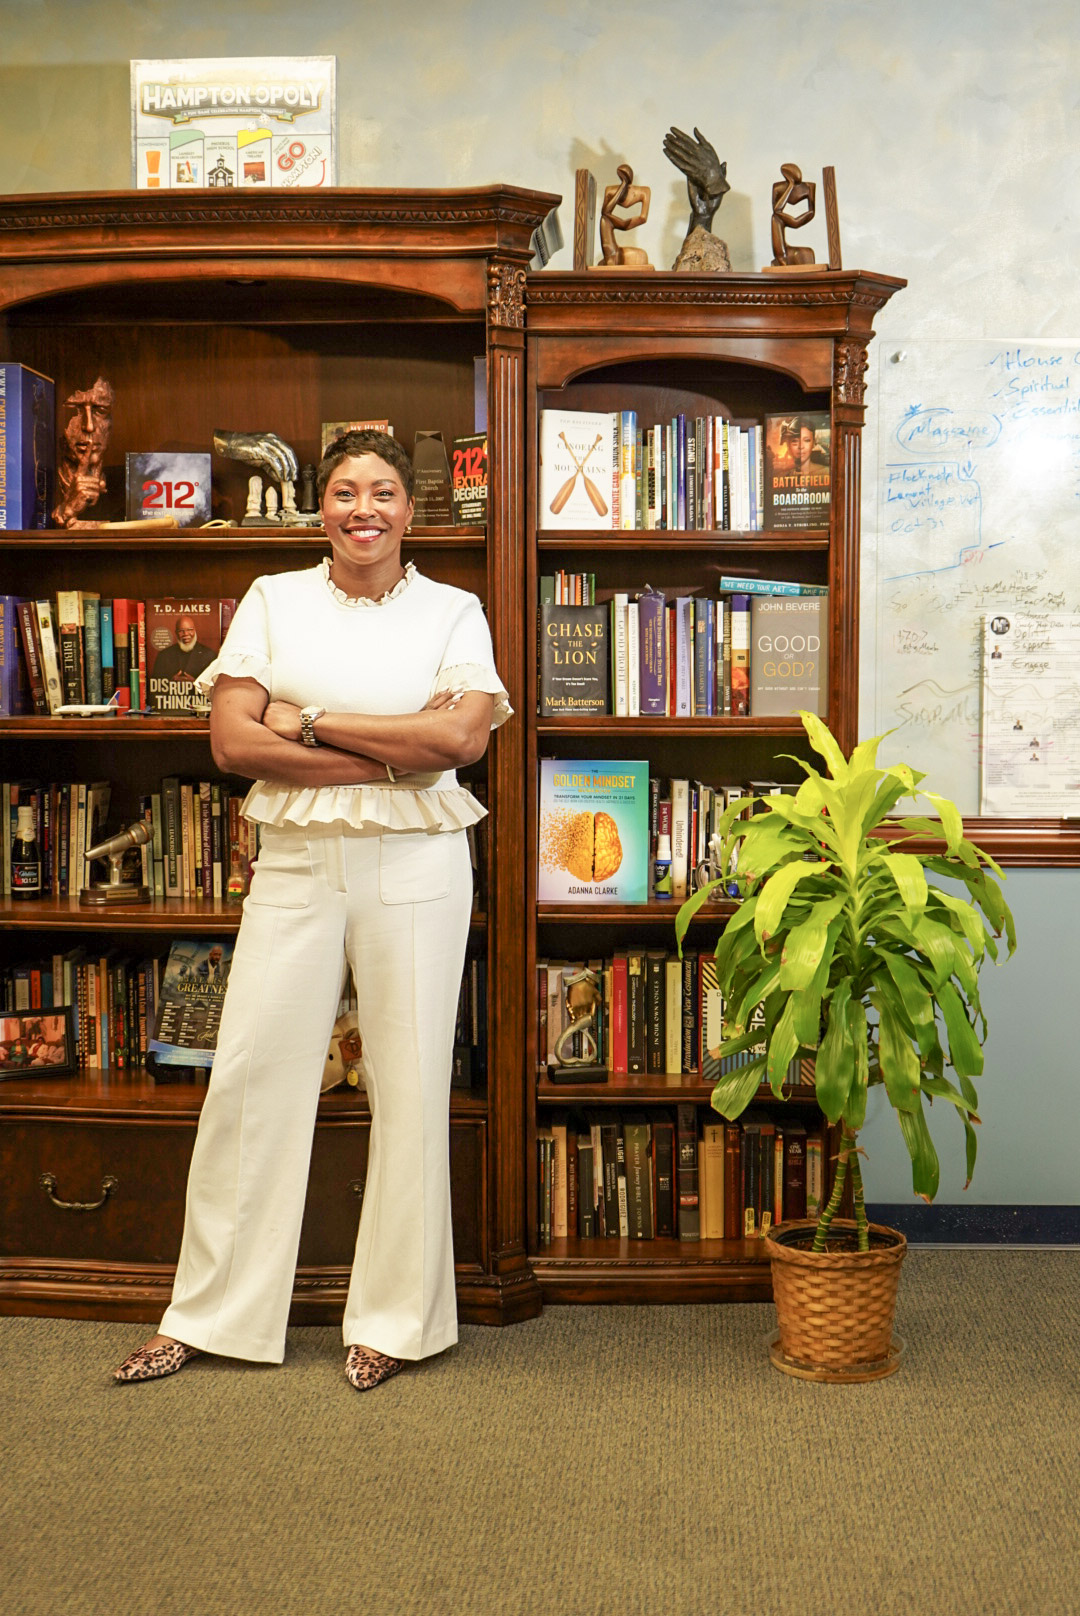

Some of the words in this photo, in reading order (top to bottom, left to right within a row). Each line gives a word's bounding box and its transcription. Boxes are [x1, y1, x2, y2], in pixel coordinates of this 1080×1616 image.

[277, 142, 305, 171] GO
[556, 442, 604, 452] CANOEING
[687, 437, 696, 463] STAND
[553, 463, 606, 473] MOUNTAINS
[773, 475, 830, 489] BATTLEFIELD
[773, 492, 830, 506] BOARDROOM
[737, 582, 755, 590] NEED
[772, 585, 787, 593] ART
[154, 604, 163, 613] T.
[165, 604, 176, 613] D.
[178, 604, 212, 613] JAKES
[758, 603, 783, 612] JOHN
[785, 602, 821, 611] BEVERE
[547, 623, 604, 637] CHASE
[567, 640, 584, 648] THE
[758, 635, 821, 652] GOOD
[63, 641, 74, 673] BIBLE
[554, 651, 597, 665] LION
[763, 661, 815, 678] GOD?
[545, 697, 567, 707] Mark
[567, 697, 605, 706] Batterson
[553, 773, 591, 787] GOLDEN
[593, 775, 636, 789] MINDSET
[675, 820, 684, 858] Unhindered!
[568, 887, 593, 895] ADANNA
[594, 887, 618, 895] CLARKE
[683, 960, 692, 996] Testament
[683, 1028, 693, 1071] Introduction
[619, 1188, 627, 1218] RODRIGUEZ
